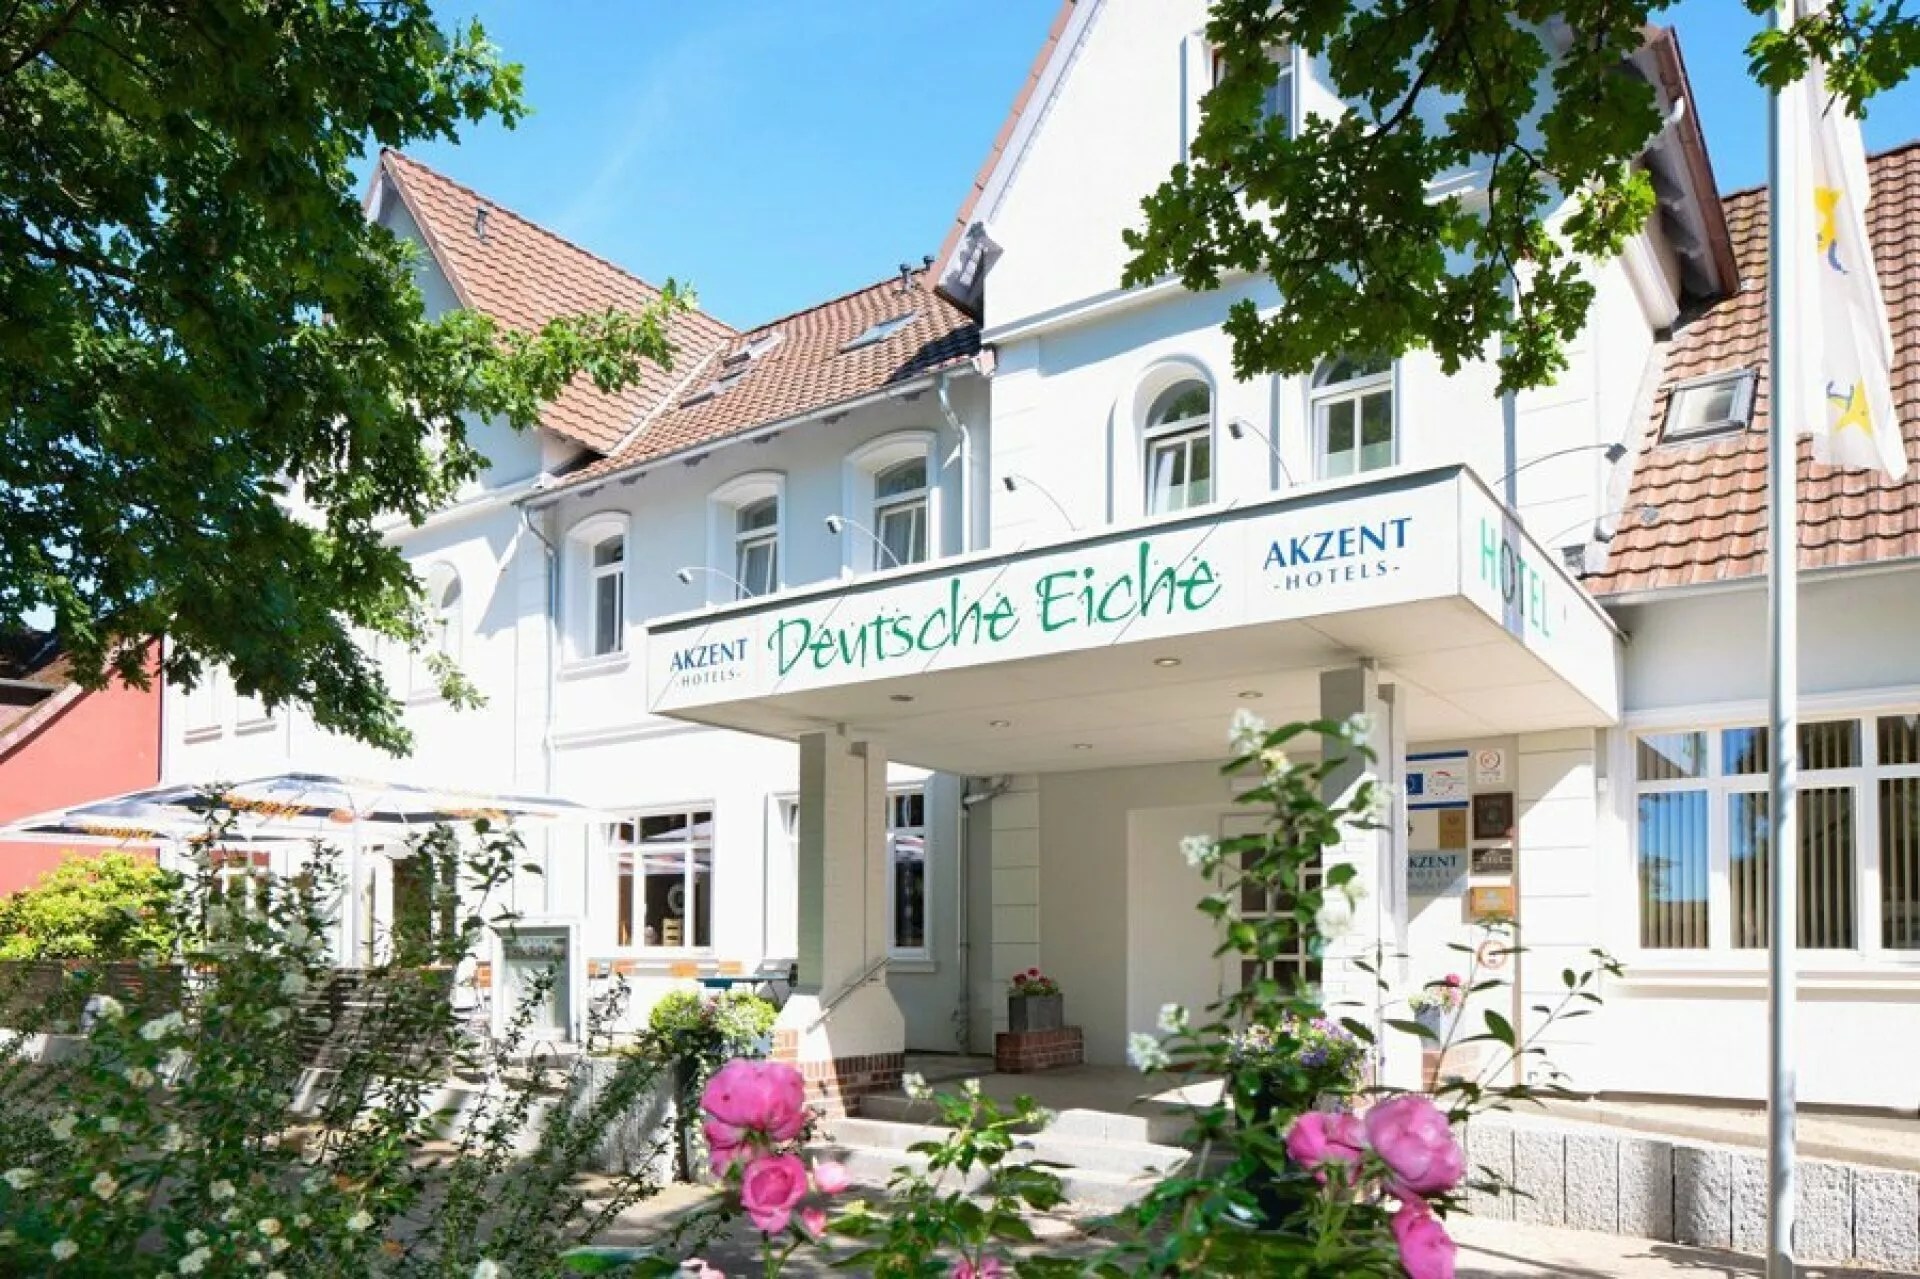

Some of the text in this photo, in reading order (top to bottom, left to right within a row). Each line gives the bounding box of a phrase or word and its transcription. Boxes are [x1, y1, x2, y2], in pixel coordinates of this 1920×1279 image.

[1263, 517, 1413, 571] AKZENT
[1479, 516, 1551, 638] HOTEL
[767, 541, 1222, 676] Deutsche Eiche
[670, 637, 748, 672] AKZENT
[1408, 854, 1457, 869] KZENT
